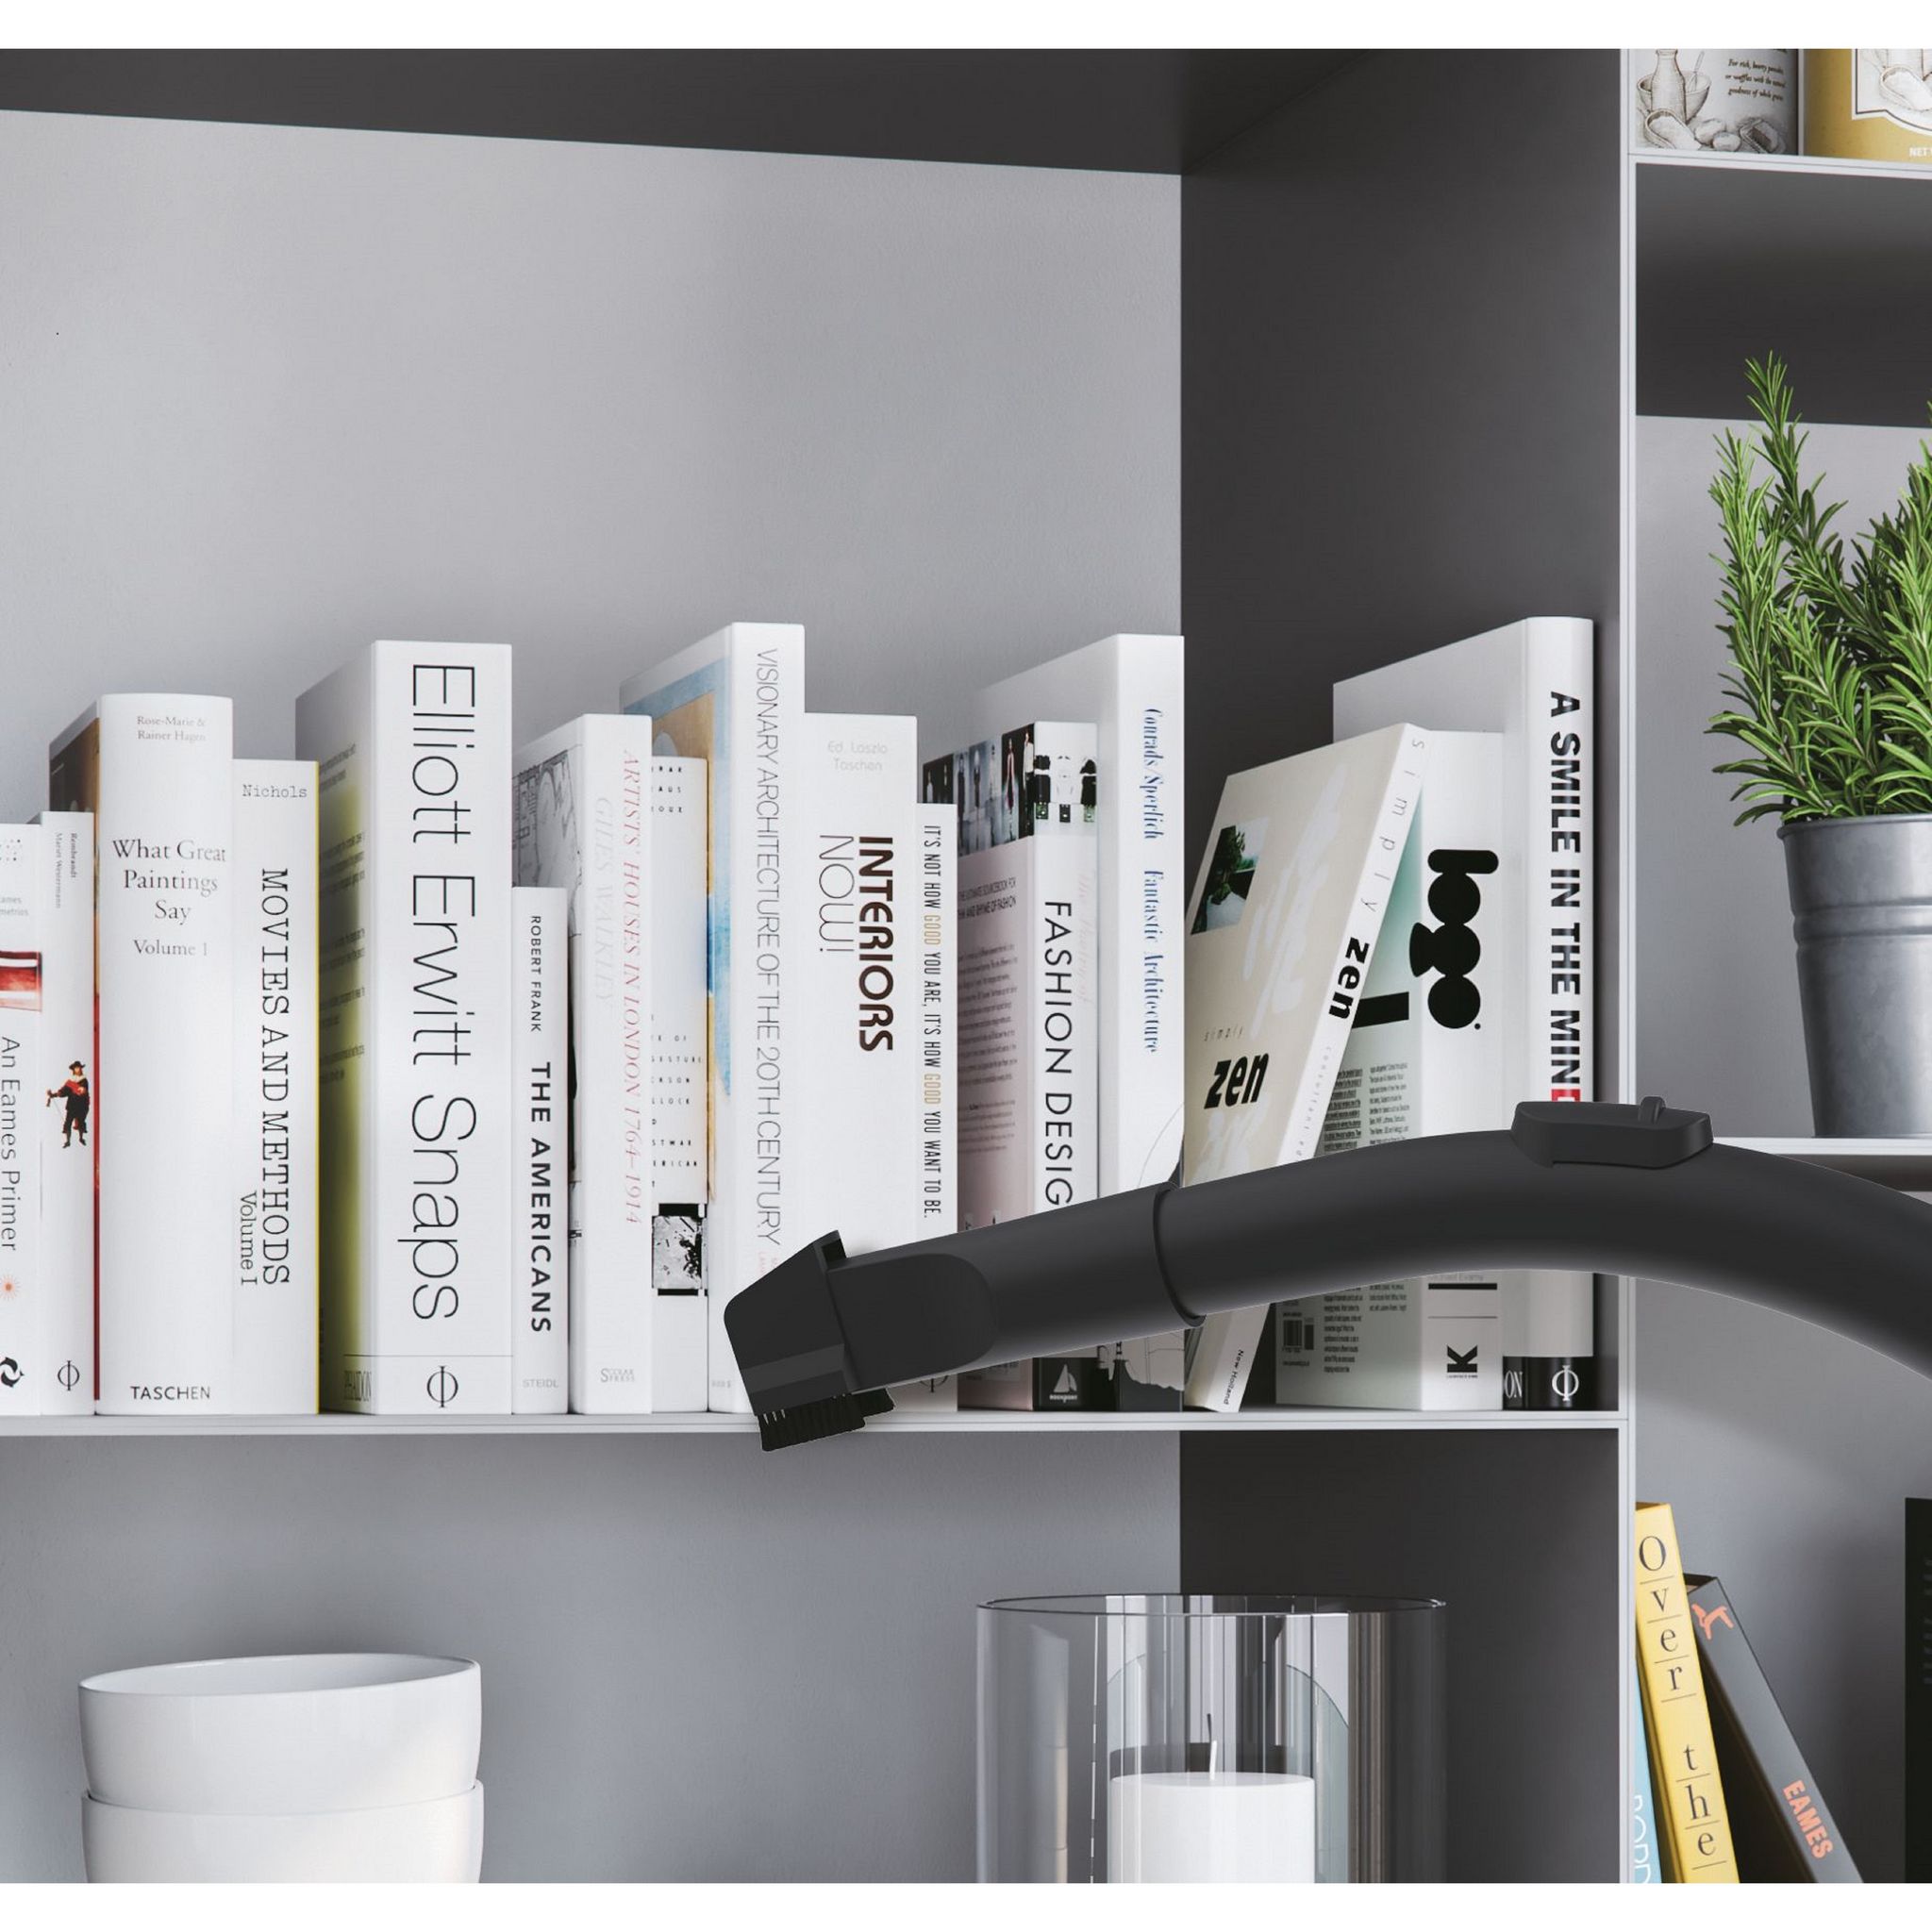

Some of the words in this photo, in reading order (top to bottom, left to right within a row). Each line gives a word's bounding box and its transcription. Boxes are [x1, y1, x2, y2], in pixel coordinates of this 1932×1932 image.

[136, 715, 193, 725] Rose-Marie
[757, 649, 778, 764] VISIONARY
[1551, 691, 1580, 717] A
[138, 730, 170, 740] Rainer
[175, 730, 205, 743] Hagen
[412, 664, 475, 843] Elliott
[242, 784, 308, 798] Nichols
[1551, 732, 1581, 853] SMILE
[112, 839, 168, 858] What
[176, 841, 225, 861] Great
[757, 768, 780, 948] ARCHITECTURE
[923, 824, 941, 849] IT'S
[924, 854, 941, 876] NOT
[124, 870, 217, 895] Paintings
[624, 862, 640, 955] HOUSES
[819, 835, 855, 952] NOW!
[924, 883, 941, 908] HOW
[1144, 871, 1163, 939] Fantastic
[1551, 869, 1580, 908] IN
[155, 900, 190, 925] Say
[261, 868, 289, 1014] MOVIES
[923, 914, 941, 946] GOOD
[133, 940, 194, 955] Volume
[413, 875, 475, 1065] Erwitt
[531, 916, 541, 974] ROBERT
[757, 954, 780, 987] OF
[858, 837, 893, 1051] INTERIORS
[924, 952, 941, 974] YOU
[1551, 923, 1580, 995] THE
[624, 963, 640, 989] IN
[923, 981, 941, 1007] ARE,
[1044, 902, 1072, 1074] FASHION
[1144, 955, 1164, 1052] Architecture
[1326, 934, 1372, 1024] zen
[531, 982, 541, 1031] FRANK
[758, 991, 779, 1040] THE
[923, 1013, 941, 1036] IT'S
[2, 1037, 20, 1067] An
[262, 1025, 289, 1101] AND
[624, 996, 640, 1096] LONDON
[924, 1041, 941, 1067] HOW
[531, 1061, 551, 1122] THE
[757, 1047, 780, 1115] 20TH
[923, 1074, 941, 1105] GOOD
[1204, 1053, 1269, 1109] zen
[1, 1079, 20, 1159] Eames
[924, 1111, 941, 1133] YOU
[924, 1141, 941, 1173] WANT
[1044, 1092, 1074, 1206] DESIG
[1, 1171, 21, 1250] Primer
[262, 1110, 290, 1284] METHODS
[397, 1095, 476, 1319] Snaps
[757, 1121, 781, 1245] CENTURY
[924, 1179, 941, 1192] TO
[241, 1191, 257, 1270] Volume
[531, 1138, 551, 1331] AMERICANS
[1447, 1345, 1477, 1373] K
[130, 1386, 209, 1400] TASCHEN
[1639, 1535, 1684, 1692] Over
[1683, 1743, 1717, 1857] the
[1782, 1779, 1834, 1859] EAMES
